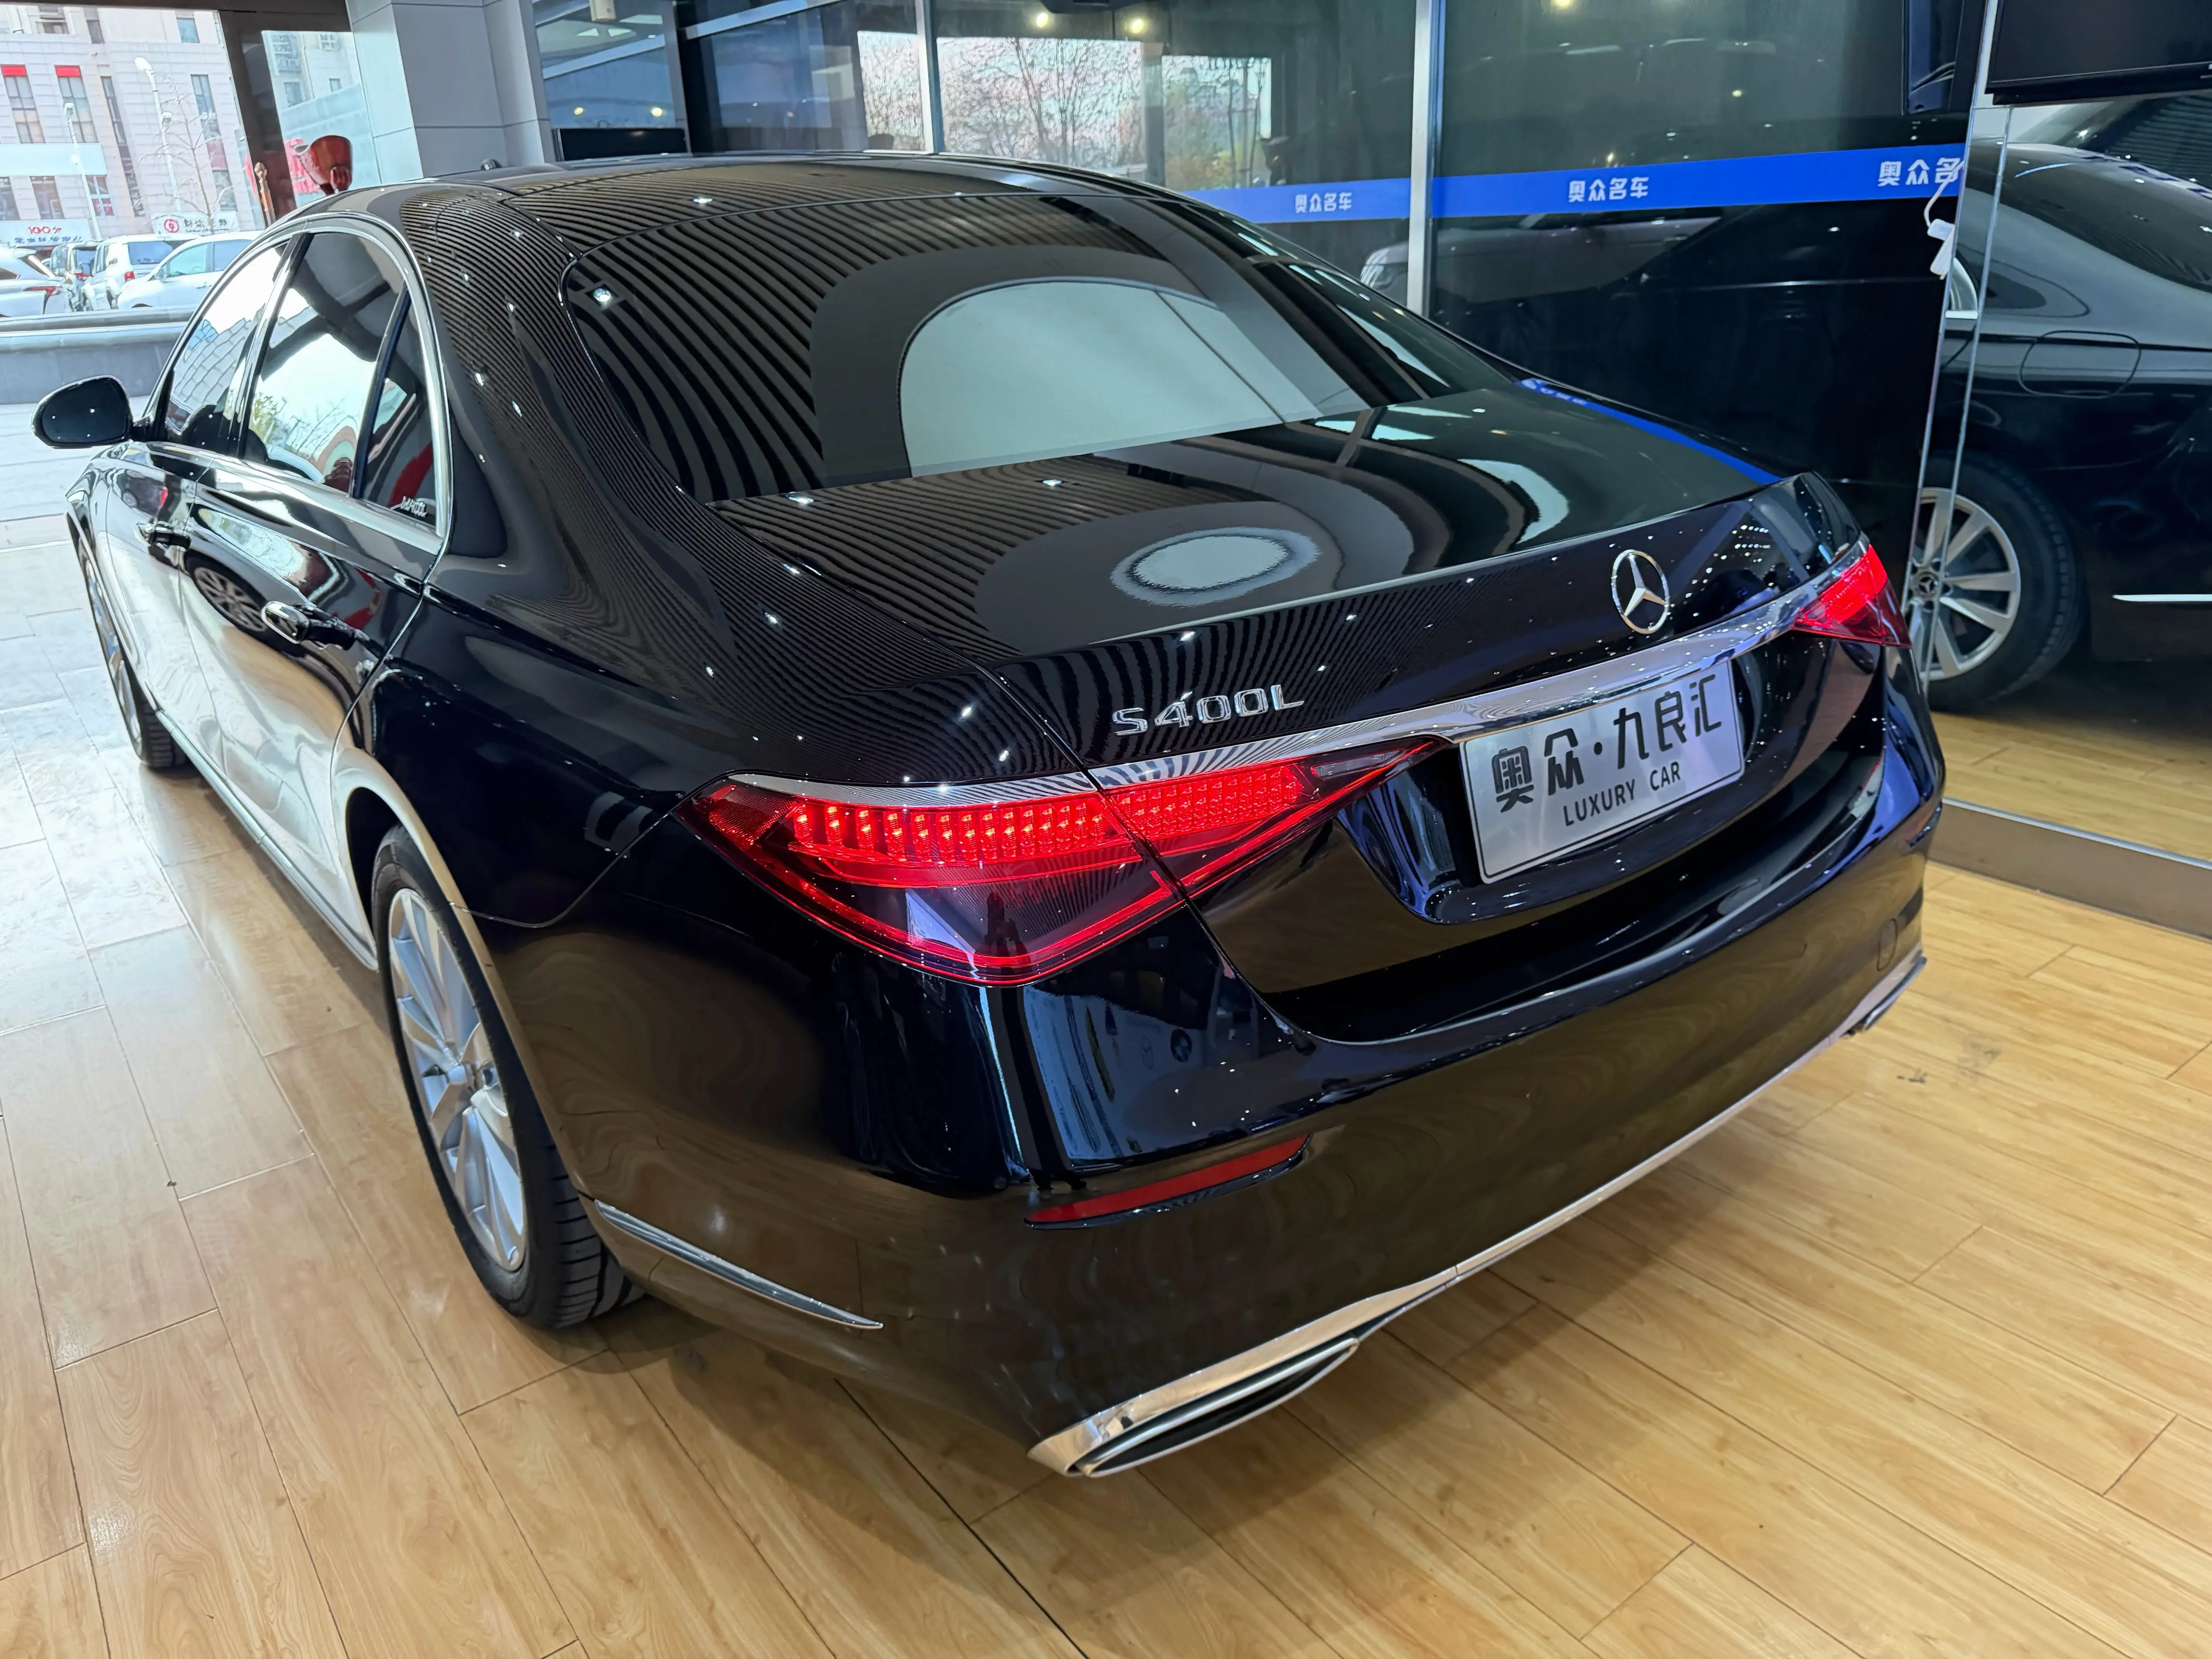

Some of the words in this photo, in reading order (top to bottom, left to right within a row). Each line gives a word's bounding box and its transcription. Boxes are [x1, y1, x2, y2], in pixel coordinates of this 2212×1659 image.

[1295, 192, 1352, 213] 奥众名车
[1568, 177, 1649, 202] 奥众名车
[1113, 684, 1304, 736] S400L
[1563, 779, 1636, 827] LUXURY
[1650, 761, 1681, 791] CAR
